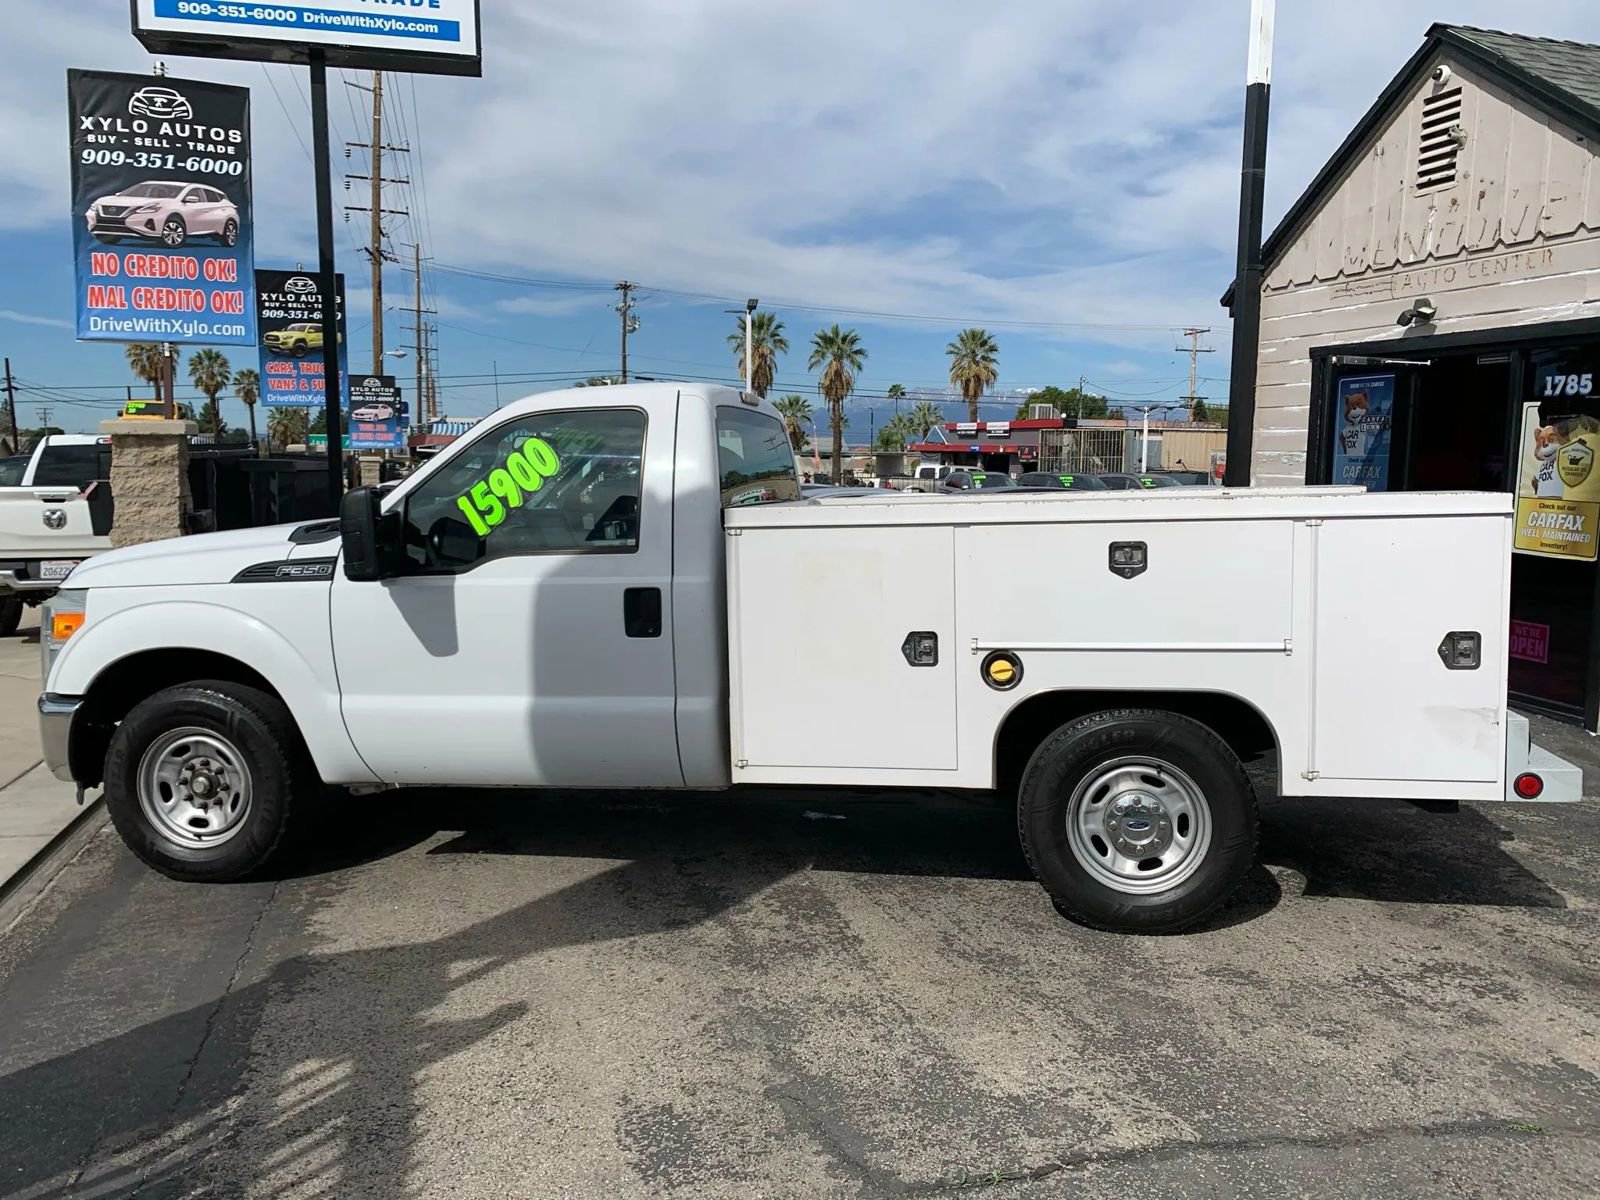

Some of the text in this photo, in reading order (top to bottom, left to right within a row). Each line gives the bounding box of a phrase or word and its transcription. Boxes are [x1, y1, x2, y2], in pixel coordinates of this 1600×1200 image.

[178, 2, 439, 33] 909-351-6000 DriveWithXylo.com
[80, 116, 242, 143] XYLO AUTOS
[87, 134, 117, 144] BUY
[134, 137, 170, 148] SELL
[187, 142, 236, 154] TRADE
[81, 149, 243, 176] 909-351-6000
[91, 252, 237, 282] NO CREDITO OK!
[88, 285, 244, 314] MAL CREDITO OK!
[261, 293, 295, 301] XYLO
[90, 316, 246, 337] DriveWithXylo.com
[266, 361, 297, 377] CARS,
[268, 378, 297, 390] VANS
[300, 378, 309, 391] &
[1544, 374, 1593, 396] 1785
[457, 437, 560, 536] 15900
[1528, 512, 1586, 531] CARFAX
[1521, 528, 1591, 543] WELL MAINTAINED
[1540, 541, 1568, 551] Inventory!
[1510, 635, 1544, 657] OPEN
